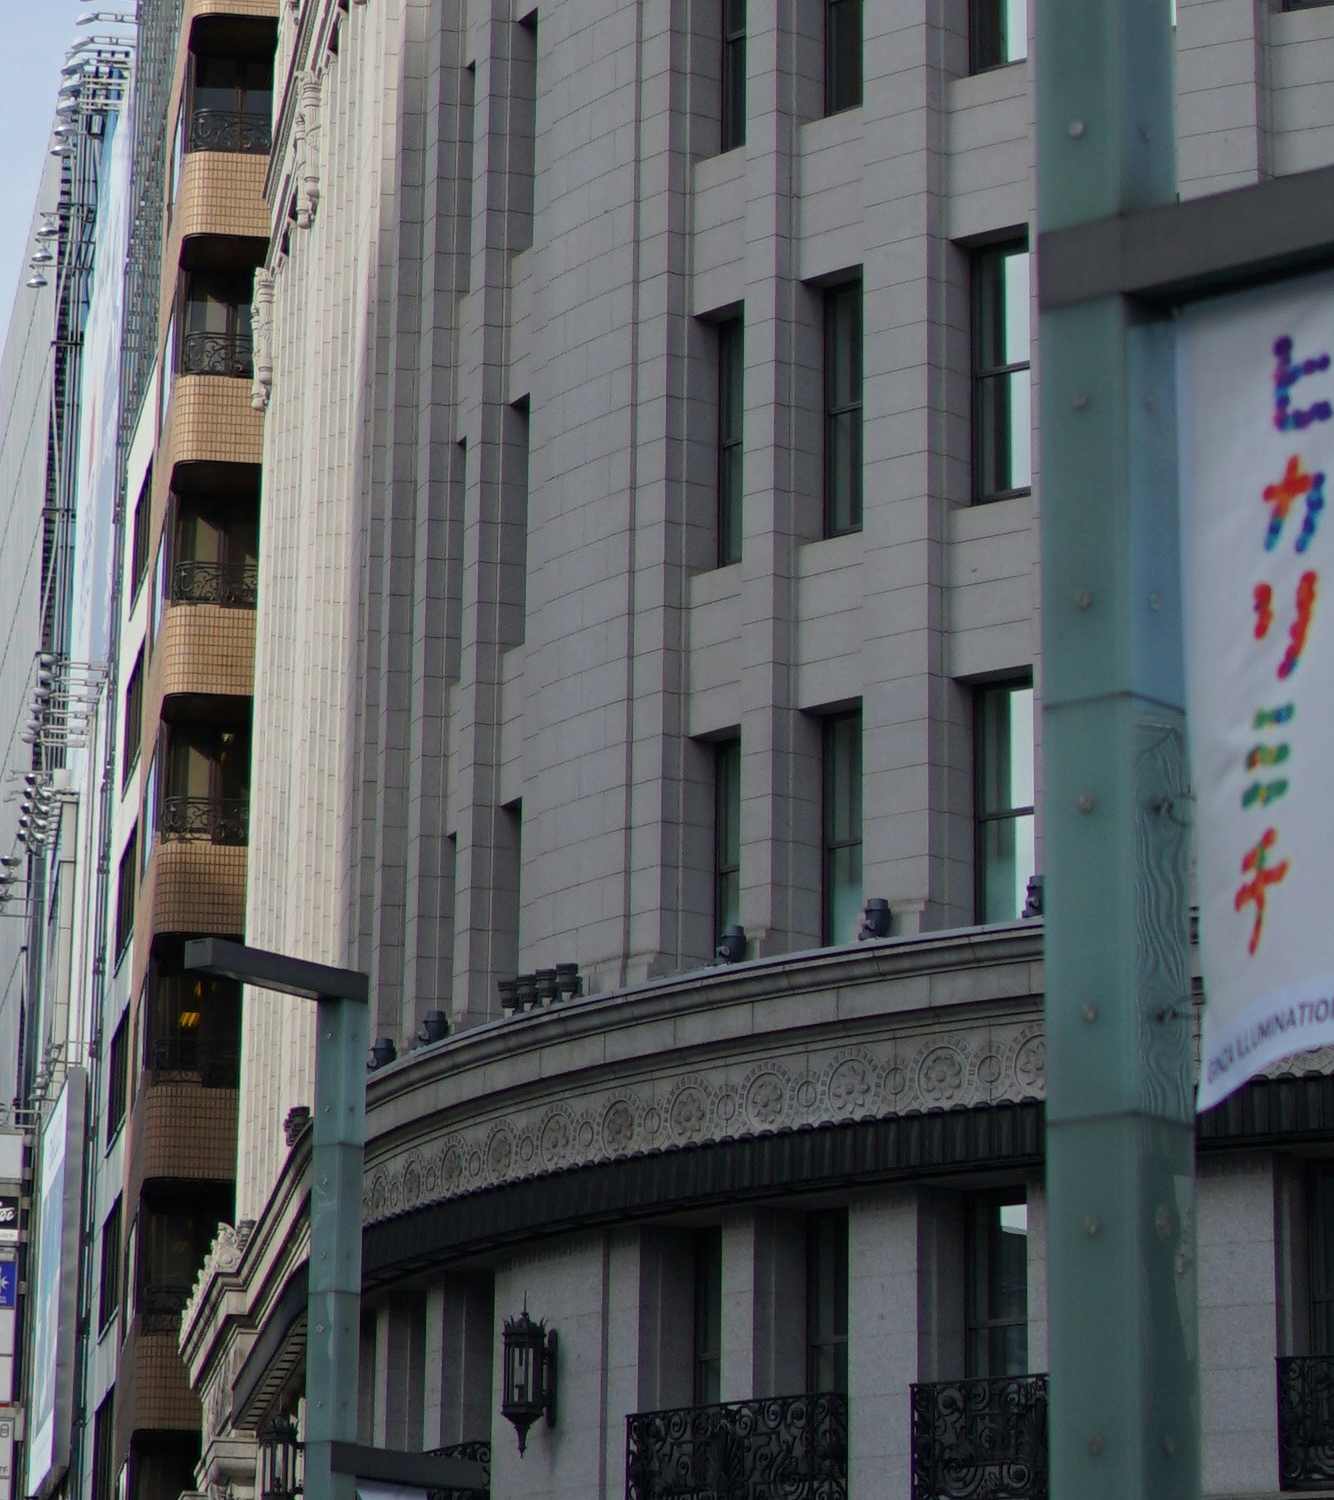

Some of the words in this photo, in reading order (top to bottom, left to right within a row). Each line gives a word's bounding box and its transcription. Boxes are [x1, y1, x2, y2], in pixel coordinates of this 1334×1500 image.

[1235, 334, 1334, 956] ヒカリミチ
